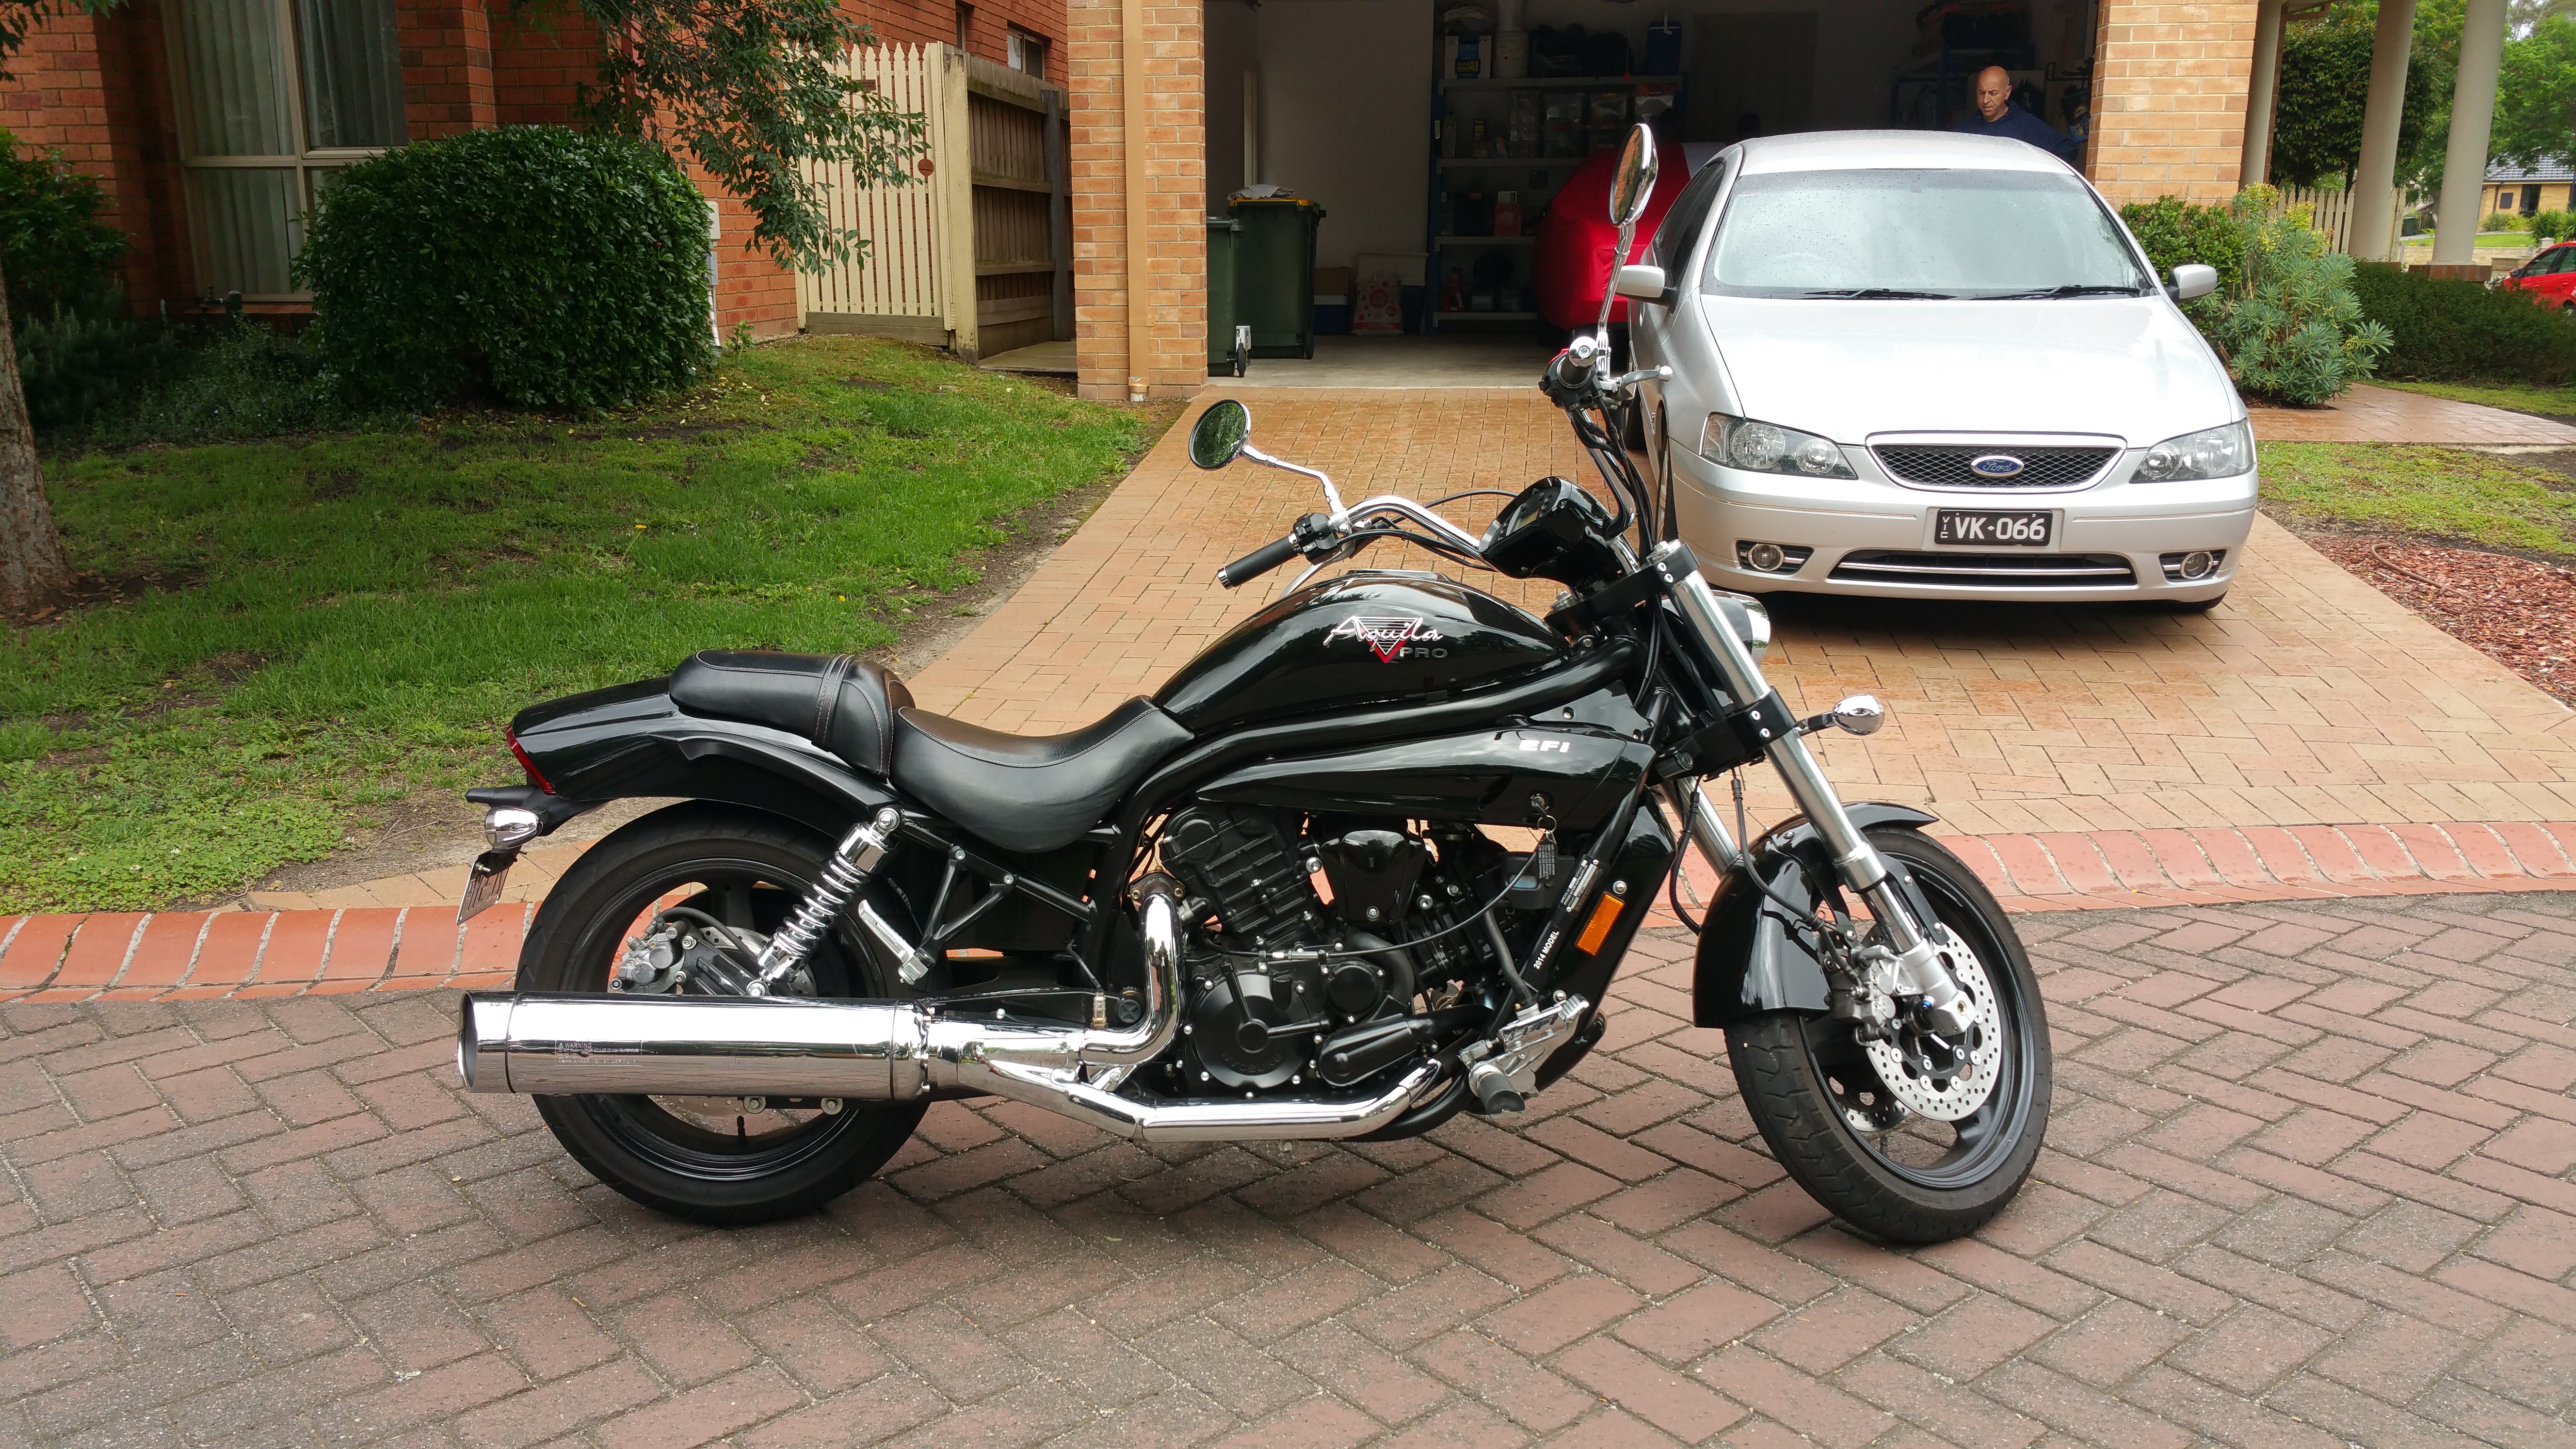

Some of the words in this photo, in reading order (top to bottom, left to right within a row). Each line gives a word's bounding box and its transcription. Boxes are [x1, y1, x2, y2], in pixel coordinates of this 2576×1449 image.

[1982, 459, 2013, 472] Ford
[1322, 615, 1444, 652] Aquila
[1399, 647, 1448, 659] PRO
[1533, 953, 1546, 969] 2014
[1542, 931, 1560, 954] MODEL
